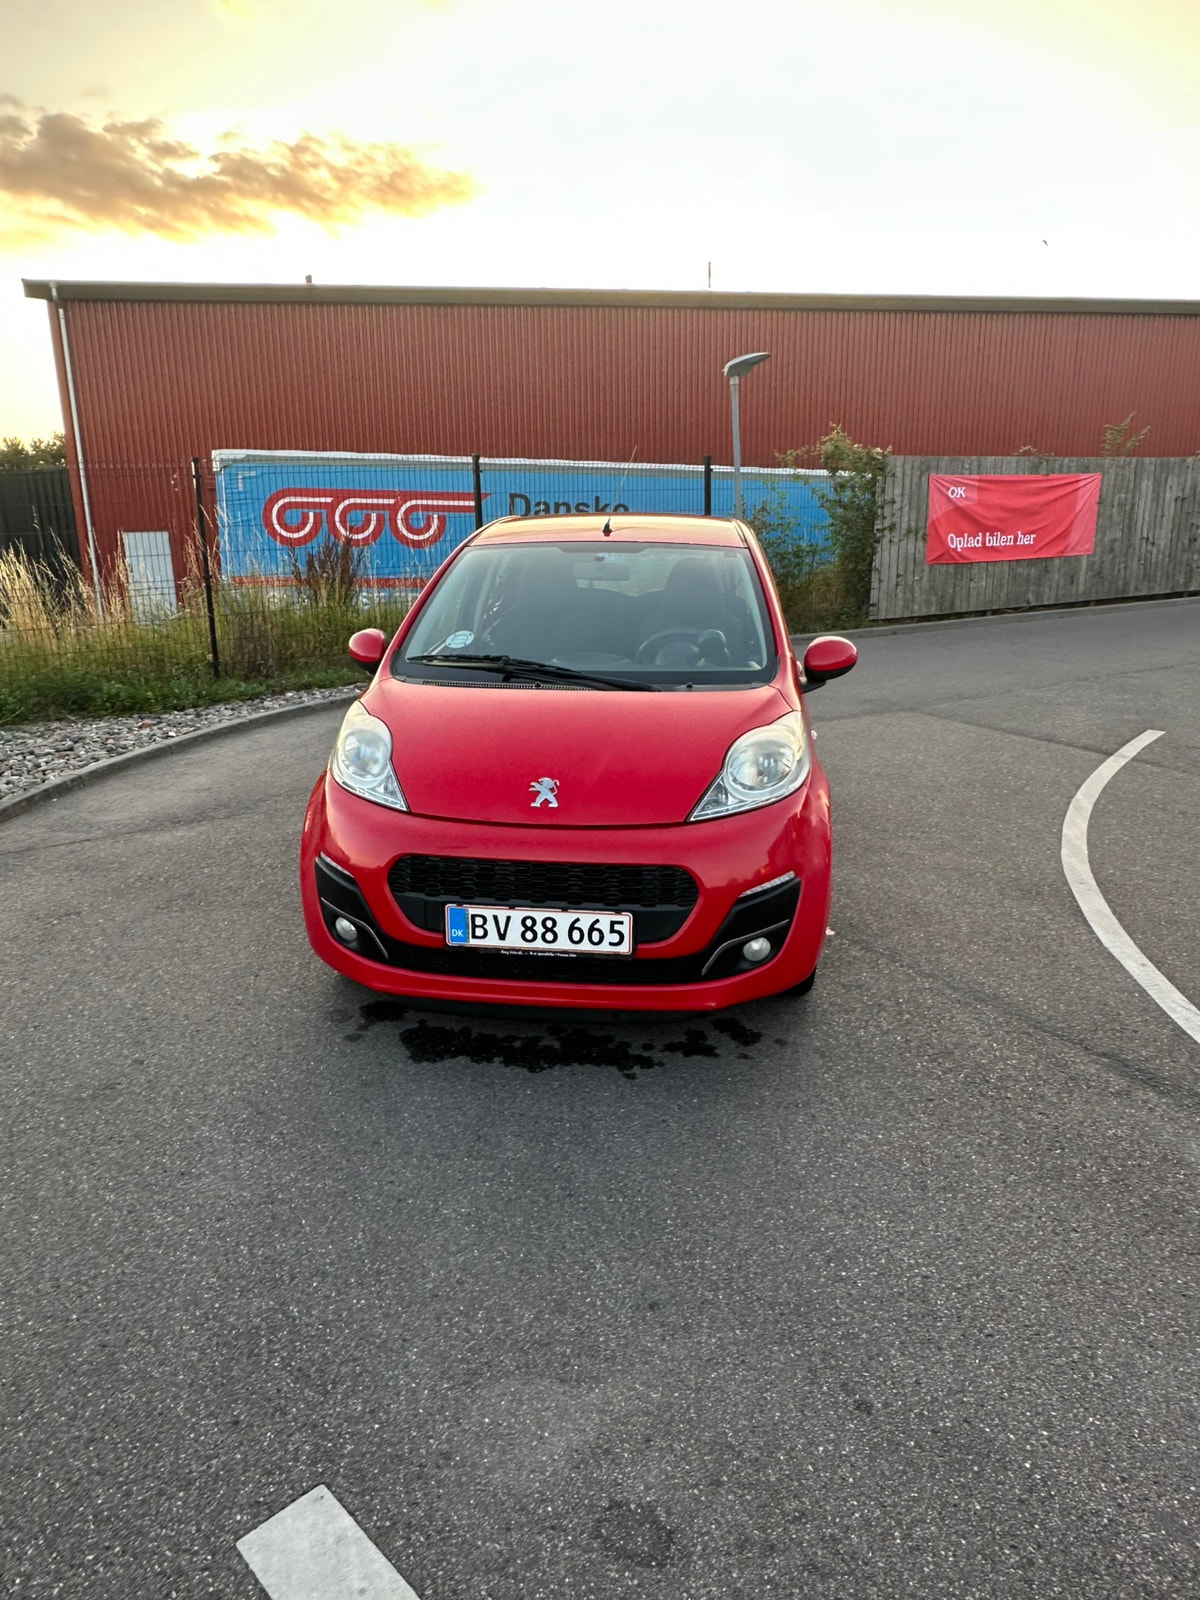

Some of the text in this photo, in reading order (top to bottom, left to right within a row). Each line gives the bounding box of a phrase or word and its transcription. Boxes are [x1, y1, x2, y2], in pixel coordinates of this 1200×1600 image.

[947, 486, 966, 498] OK
[947, 531, 1036, 552] Oplad bilen her
[451, 928, 464, 938] DK
[470, 913, 625, 947] BV 88 665
